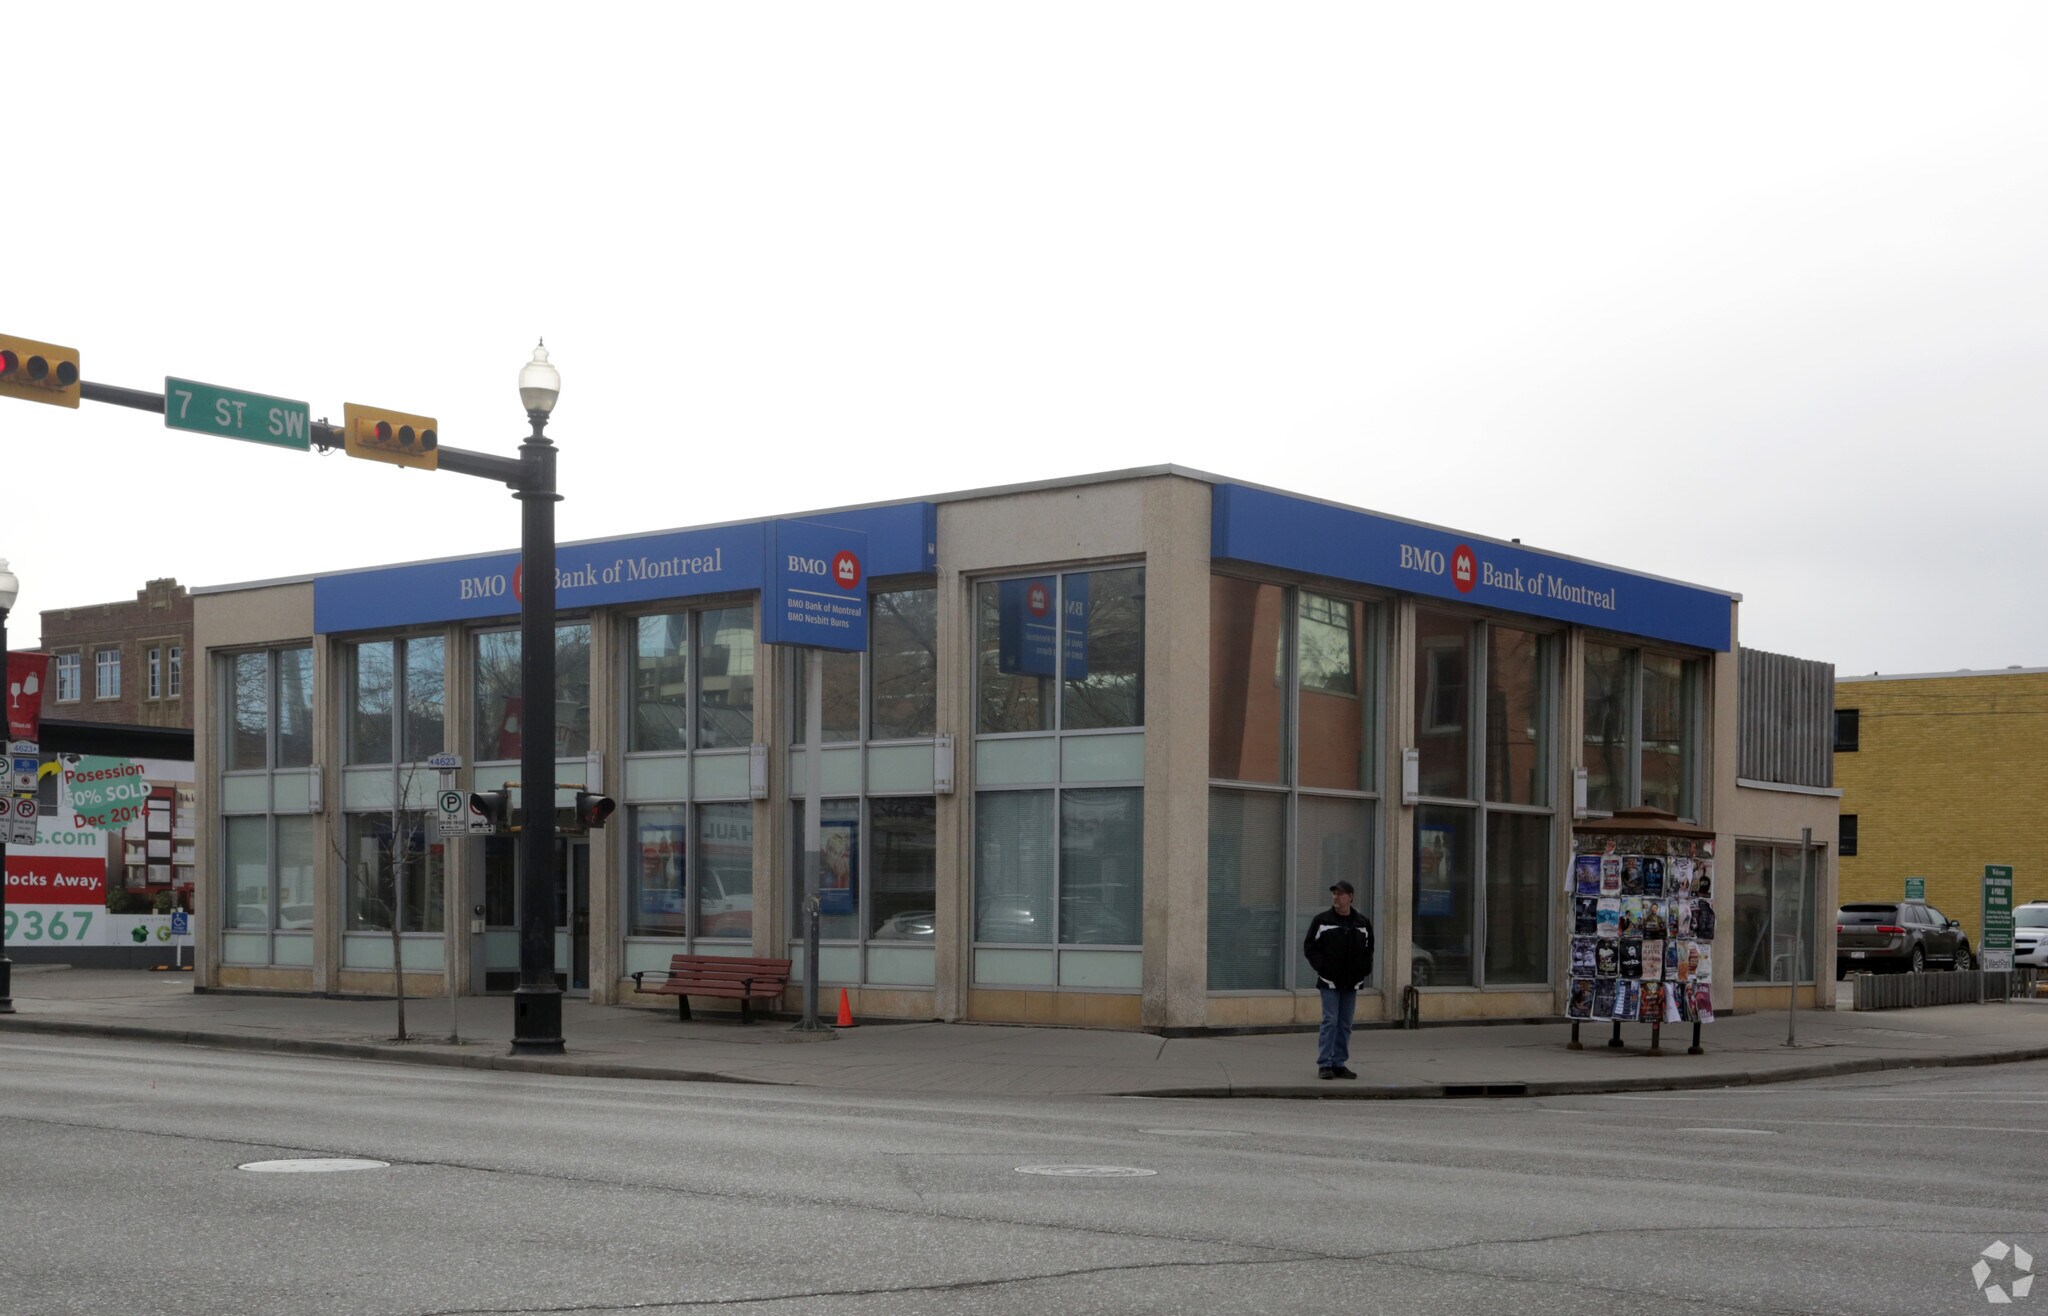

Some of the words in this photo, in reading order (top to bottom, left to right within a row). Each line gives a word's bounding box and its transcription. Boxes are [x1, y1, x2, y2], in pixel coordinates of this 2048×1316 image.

[175, 390, 193, 419] 7
[214, 398, 247, 429] ST
[267, 407, 304, 439] SW
[459, 574, 506, 600] BMO
[602, 559, 623, 585] of
[626, 548, 722, 581] Montreal
[787, 555, 827, 576] BMO
[1400, 543, 1445, 576] BMO
[1482, 561, 1525, 592] Bank
[1527, 573, 1545, 596] of
[1547, 575, 1616, 611] Montreal
[787, 598, 804, 609] BMO
[805, 600, 822, 611] Bank
[823, 603, 832, 612] of
[832, 604, 862, 617] Montreal
[787, 612, 804, 622] BMO
[805, 614, 829, 626] Nesbitt
[830, 617, 850, 628] Burns
[434, 757, 456, 766] 4623
[64, 762, 145, 784] Posession
[105, 782, 153, 802] SOLD
[447, 796, 458, 809] P
[74, 813, 106, 829] Dec
[110, 803, 151, 823] 2014
[35, 830, 97, 846] s.com
[5, 871, 47, 886] locks
[53, 872, 102, 890] Away.
[4, 910, 94, 941] 9367
